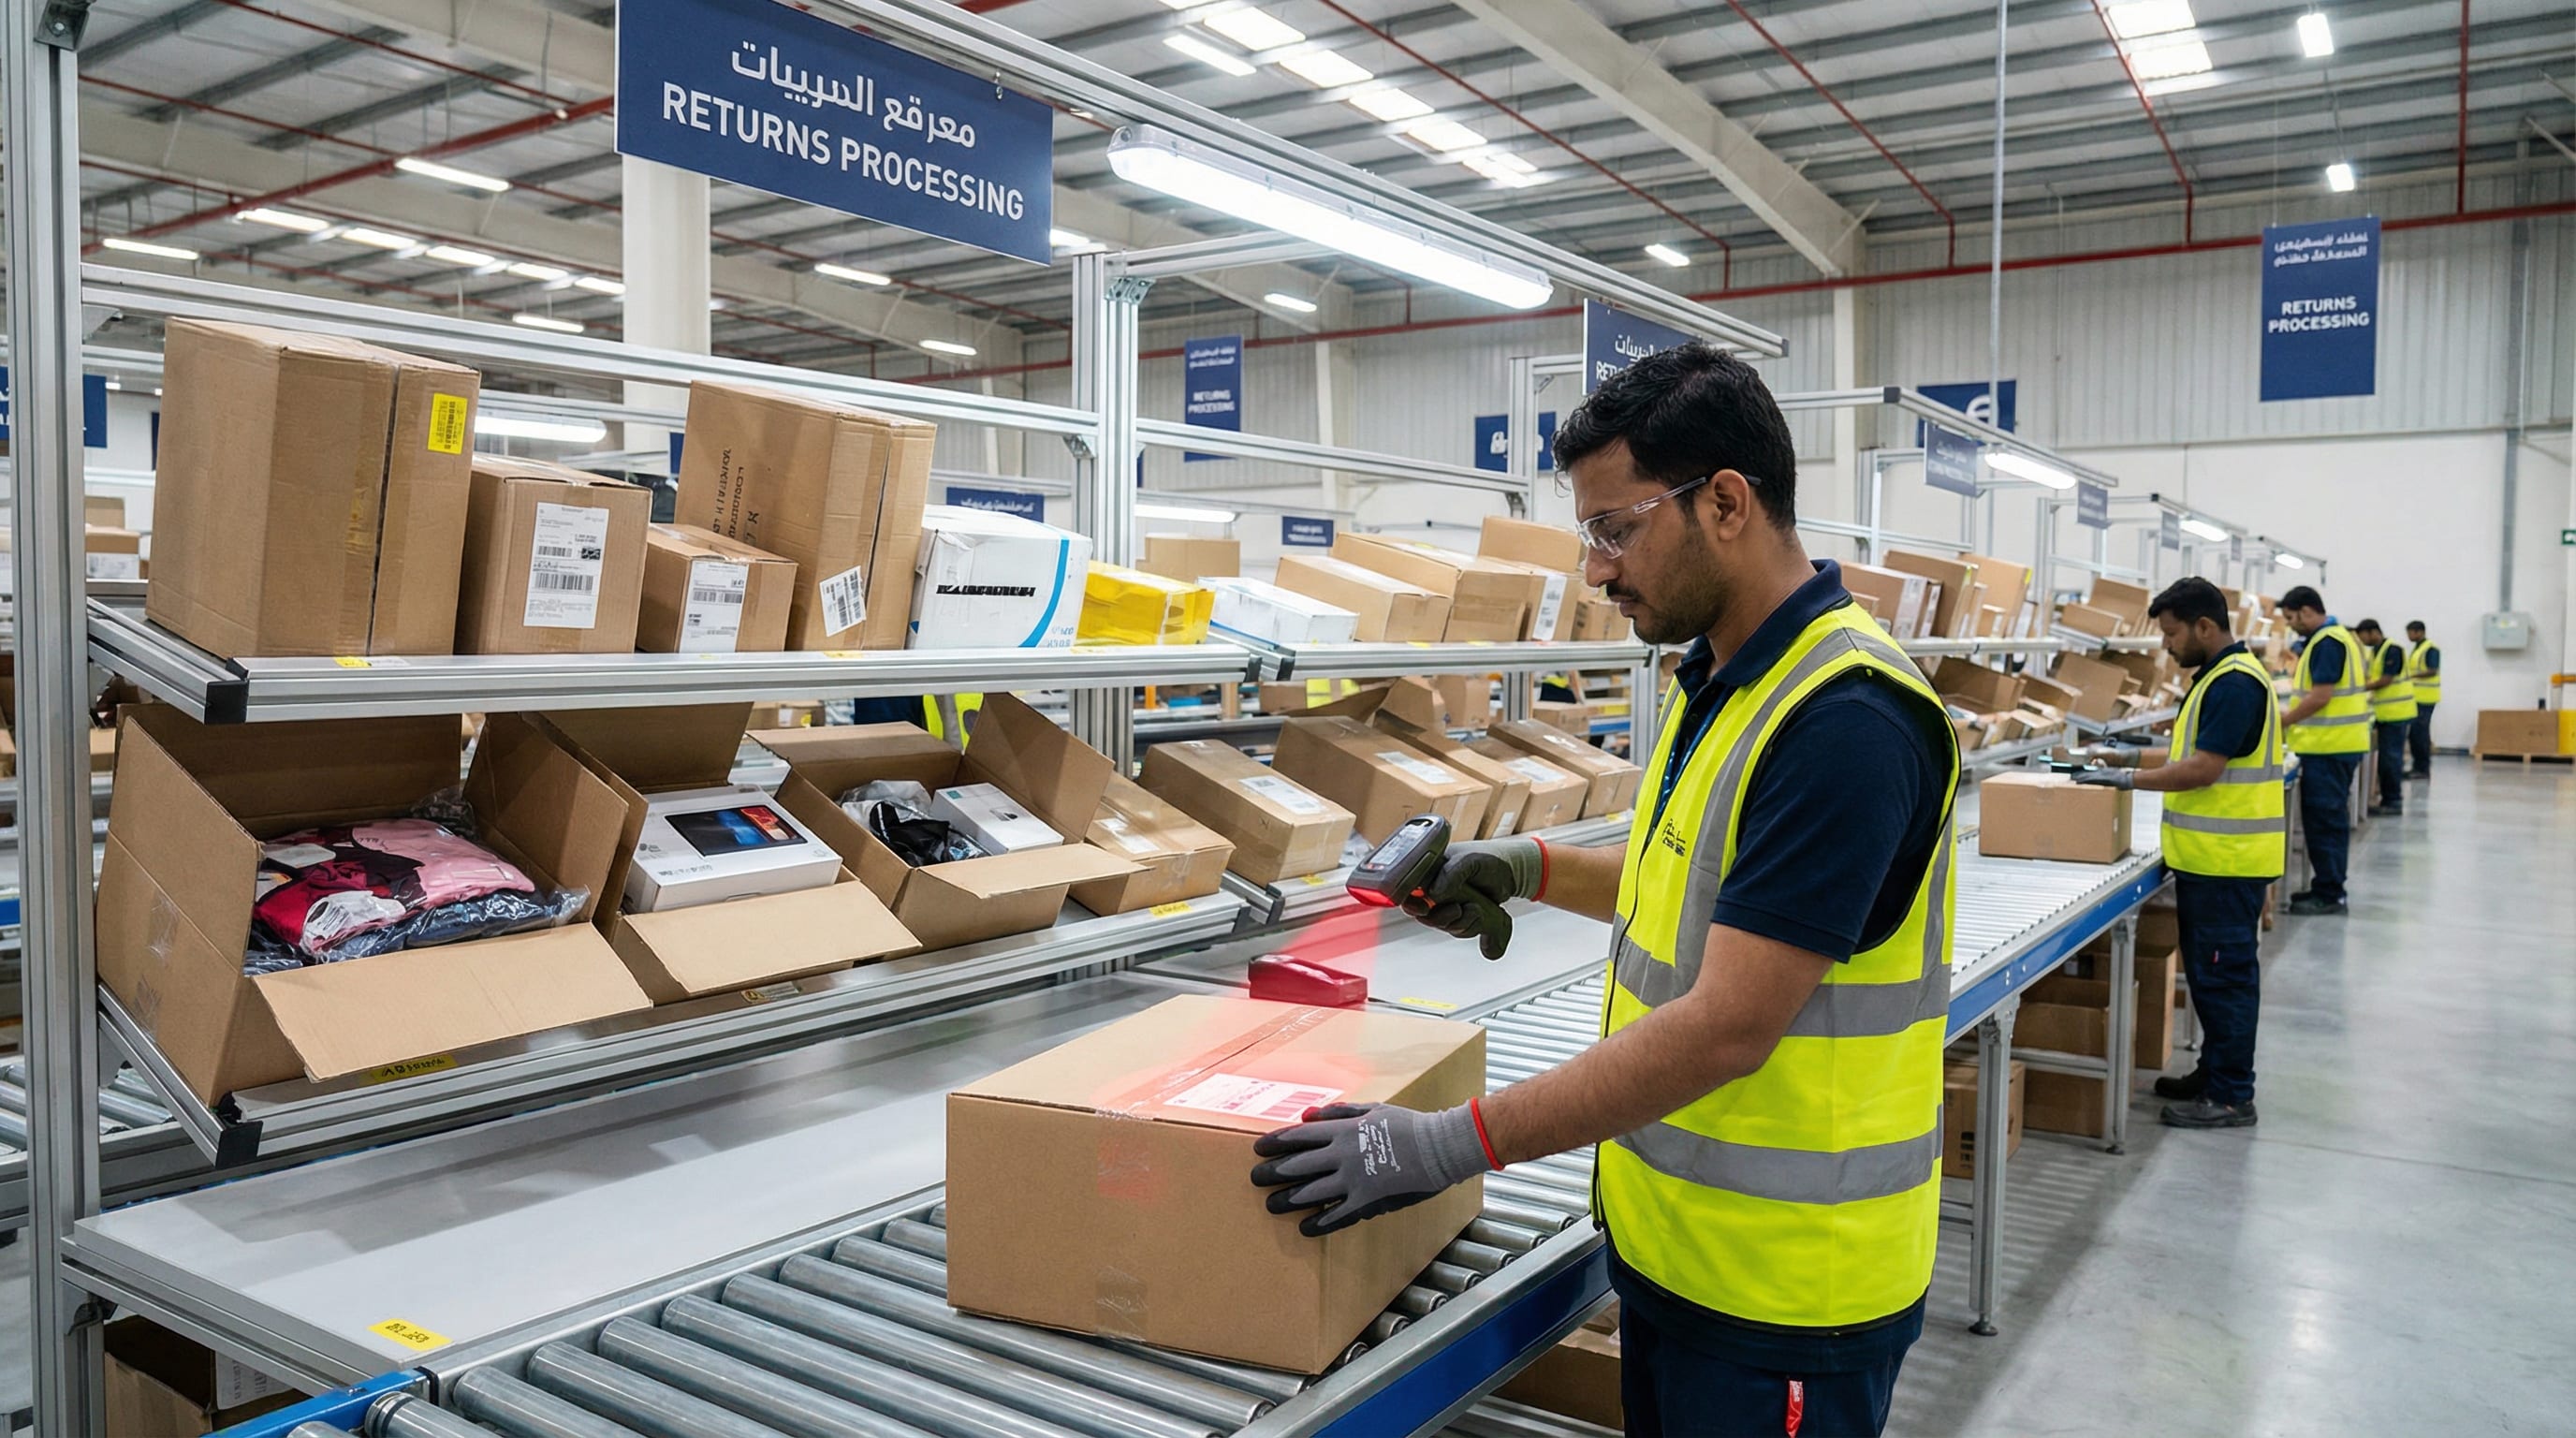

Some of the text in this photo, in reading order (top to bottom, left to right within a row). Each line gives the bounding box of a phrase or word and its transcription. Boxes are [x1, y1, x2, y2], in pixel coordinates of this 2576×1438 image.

[662, 81, 1024, 221] RETURNS PROCESSING
[2281, 296, 2356, 315] RETURNS
[2268, 312, 2370, 333] PROCESSING
